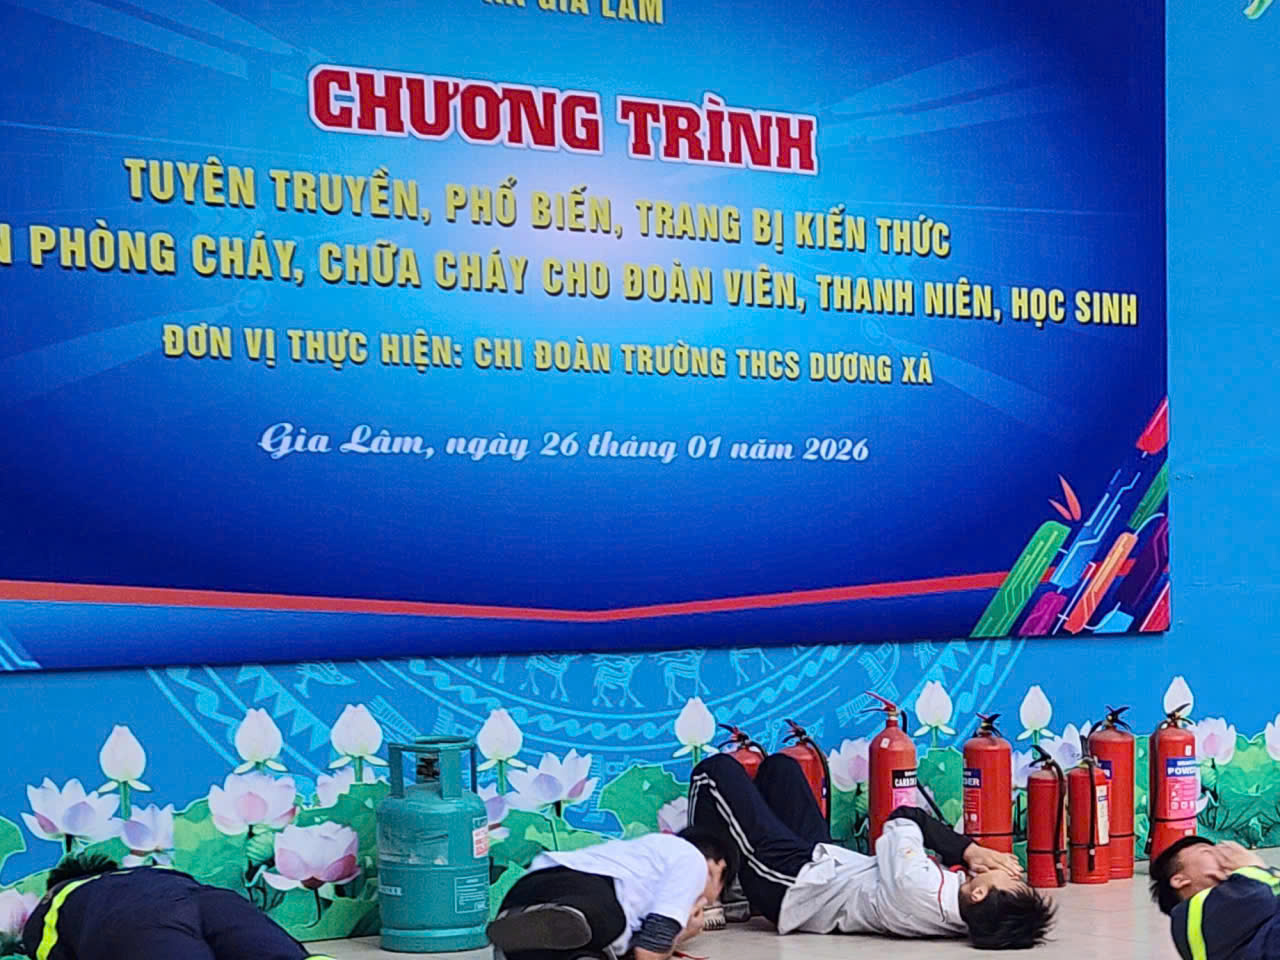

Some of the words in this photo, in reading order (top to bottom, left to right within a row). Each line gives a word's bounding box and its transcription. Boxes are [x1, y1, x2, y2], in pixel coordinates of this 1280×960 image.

[309, 64, 601, 152] CHƯƠNG
[616, 92, 819, 175] TRÌNH
[123, 156, 255, 207] TUYÊN
[269, 165, 432, 225] TRUYỀN,
[445, 176, 519, 227] PHỔ
[531, 186, 623, 238] BIẾN,
[635, 201, 742, 243] TRANG
[752, 209, 785, 254] BỊ
[795, 203, 867, 252] KIẾN
[876, 213, 951, 257] THỨC
[29, 218, 177, 275] PHÒNG
[192, 231, 305, 285] CHÁY,
[319, 240, 421, 287] CHỮA
[434, 249, 529, 293] CHÁY
[542, 258, 611, 298] CHO
[623, 259, 713, 304] ĐOÀN
[723, 264, 807, 313] VIÊN,
[815, 274, 915, 315] THANH
[924, 276, 1003, 323] NIÊN,
[1011, 287, 1065, 328] HỌC
[1074, 290, 1138, 326] SINH
[162, 322, 233, 360] ĐƠN
[243, 327, 277, 368] VỊ
[287, 328, 369, 370] THỰC
[381, 328, 464, 373] HIỆN:
[473, 337, 524, 371] CHI
[534, 336, 611, 374] ĐOÀN
[620, 339, 727, 380] TRƯỜNG
[735, 348, 801, 381] THCS
[809, 351, 893, 384] DƯƠNG
[901, 351, 933, 386] XÁ
[340, 424, 436, 460] Lâm,
[445, 433, 530, 461] ngày
[540, 431, 580, 457] 26
[587, 431, 678, 464] tháng
[687, 435, 722, 460] 01
[729, 438, 796, 461] năm
[802, 437, 870, 462] 2026
